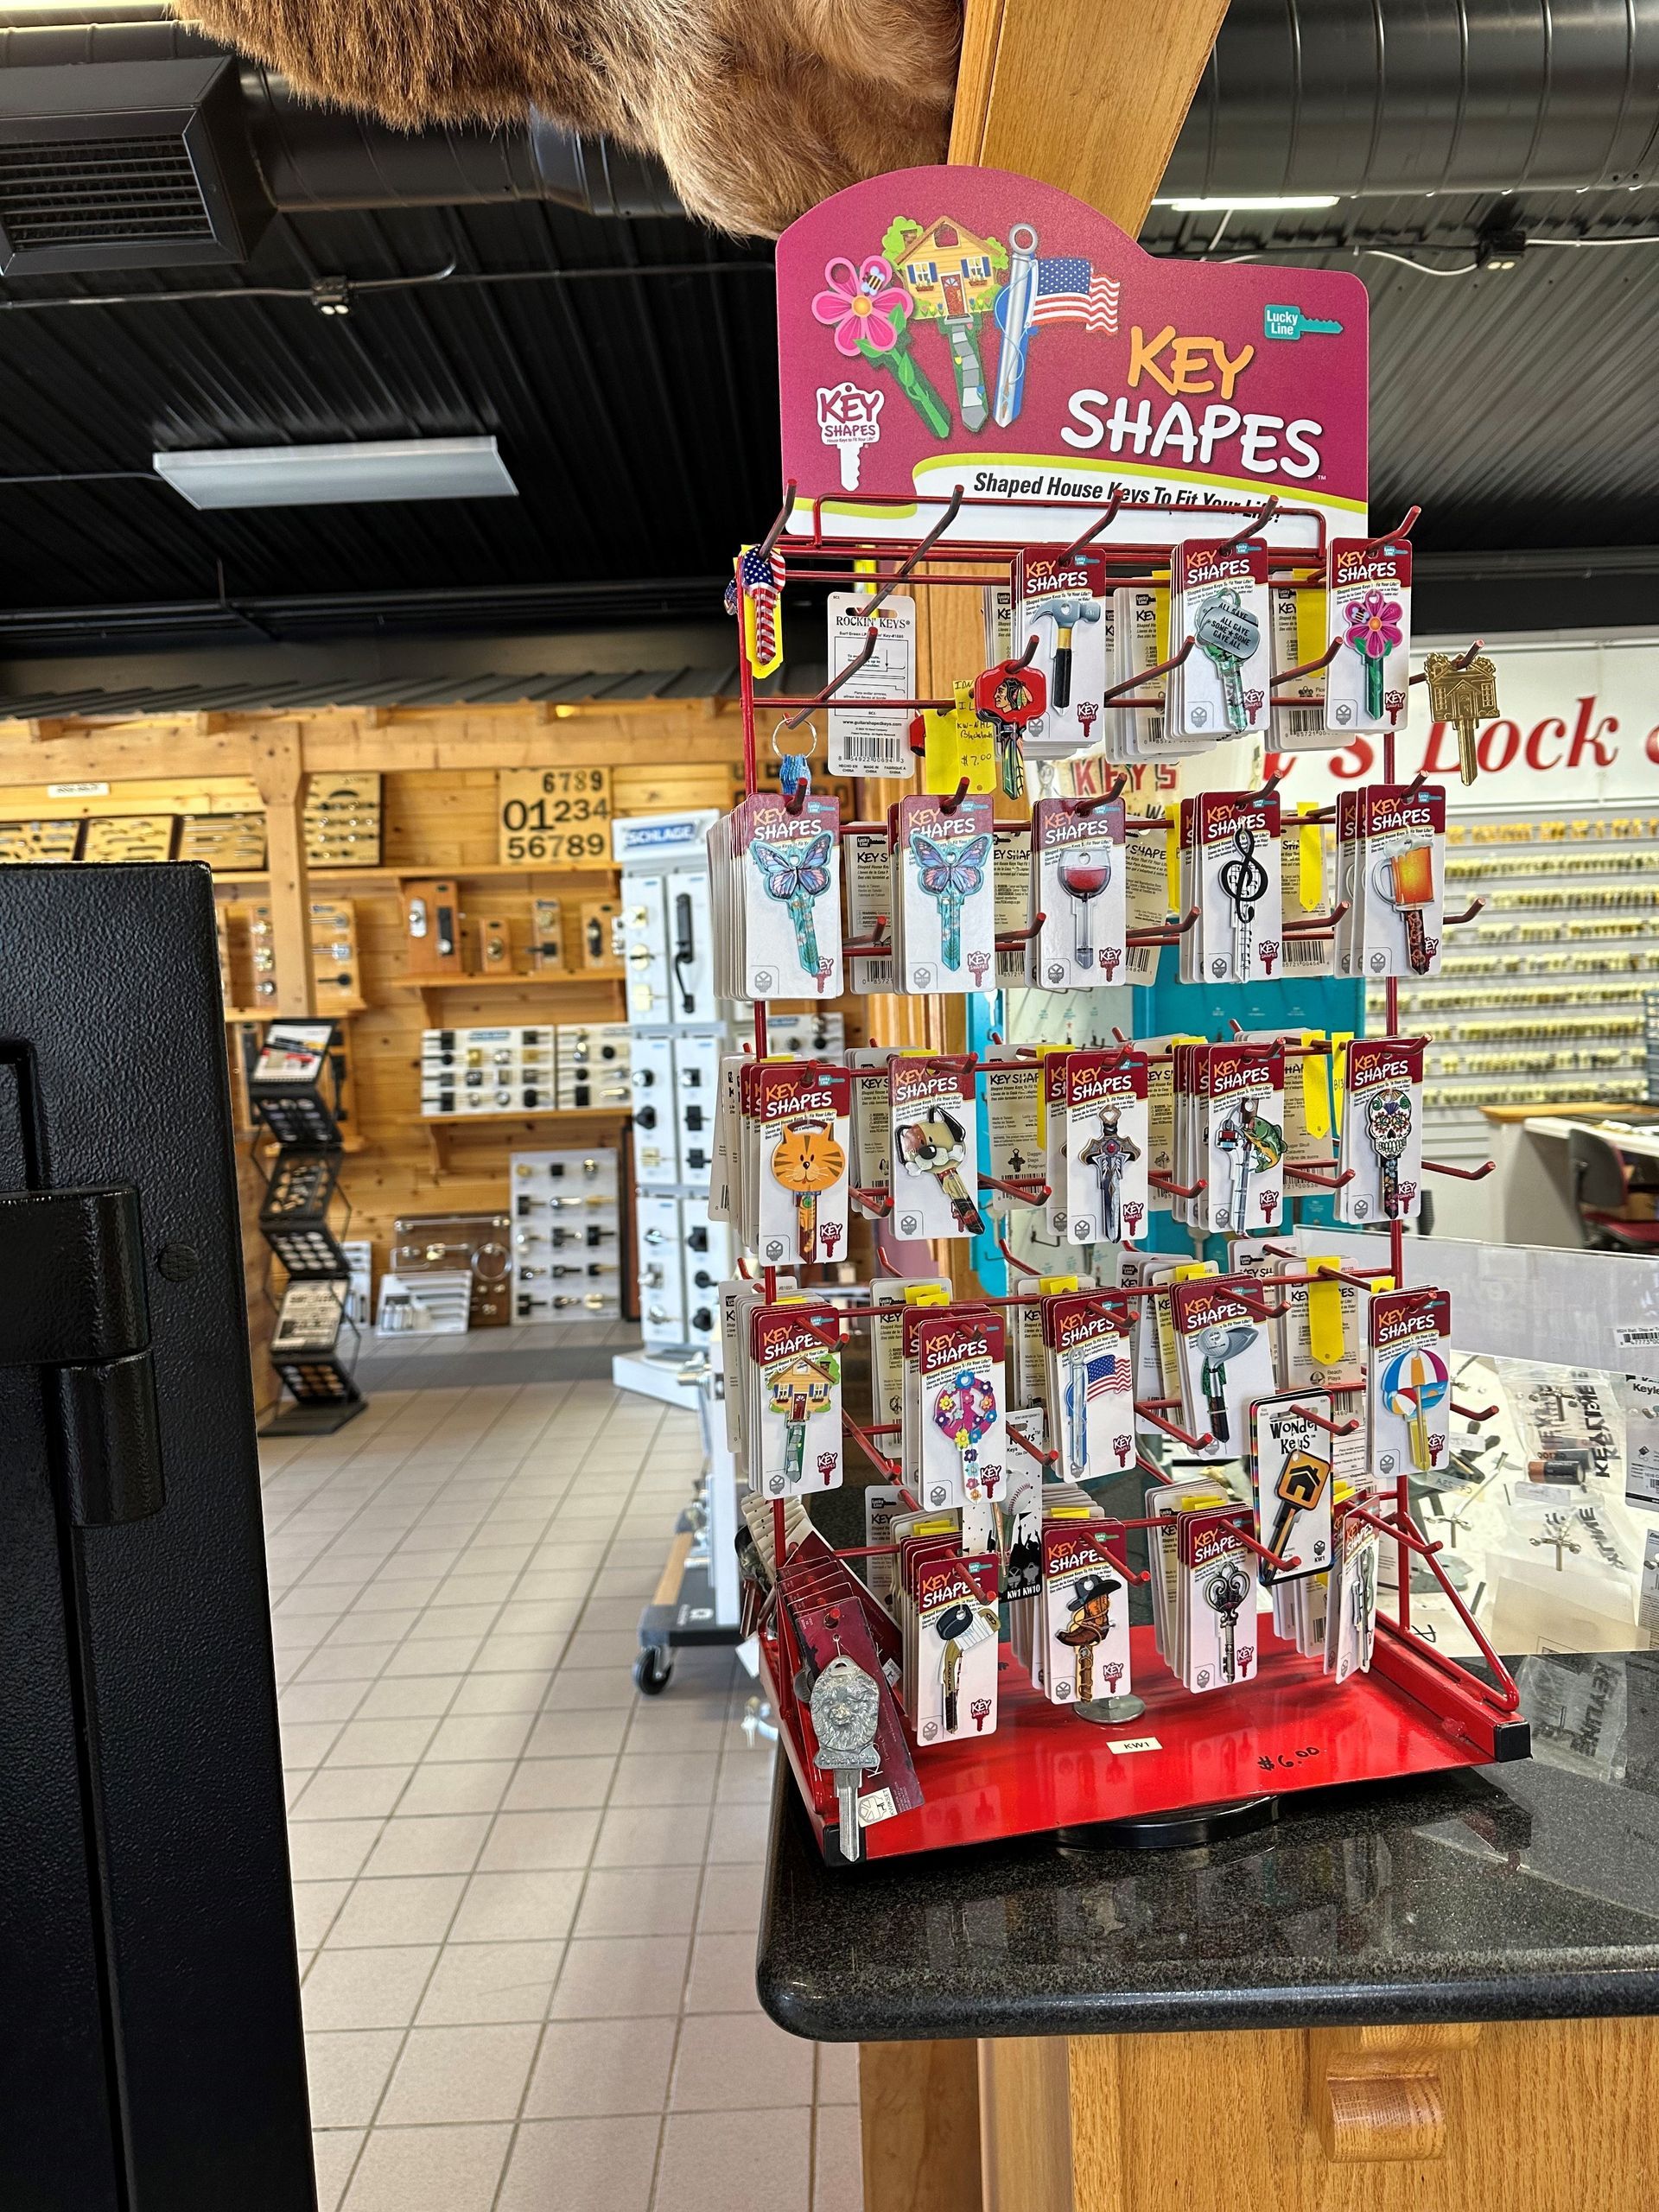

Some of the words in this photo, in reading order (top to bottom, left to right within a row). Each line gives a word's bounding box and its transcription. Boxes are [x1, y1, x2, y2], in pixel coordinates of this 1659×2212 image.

[1266, 309, 1298, 326] Lucky
[1271, 322, 1294, 335] Line
[1127, 325, 1254, 400] KEY
[820, 391, 880, 423] KEY
[824, 425, 875, 436] SHAPES
[1060, 389, 1322, 478] SHAPES
[974, 472, 1044, 498] Shaped
[1047, 477, 1103, 499] House
[1154, 486, 1172, 505] To
[1176, 489, 1198, 505] Fit
[1186, 550, 1217, 569] KEY
[1338, 550, 1365, 568] KEY
[1026, 561, 1056, 578] KEY
[1187, 559, 1249, 584] SHAPES
[1338, 563, 1396, 583] SHAPES
[1026, 571, 1088, 594] SHAPES
[836, 616, 876, 626] ROCKIN'
[1220, 617, 1231, 627] ALL
[1232, 622, 1250, 636] GAVE
[1211, 620, 1228, 634] SOME
[1235, 633, 1251, 646] SOME
[1213, 630, 1229, 643] GAVE
[1230, 638, 1241, 650] ALL
[1385, 691, 1404, 704] KEY
[1077, 704, 1098, 715] KEY
[1419, 696, 1620, 778] Lock
[753, 808, 787, 826] KEY
[1207, 804, 1236, 823] KEY
[1371, 798, 1401, 817] KEY
[908, 808, 941, 828] KEY
[1044, 812, 1075, 830] KEY
[1208, 813, 1266, 838] SHAPES
[1371, 808, 1431, 831] SHAPES
[626, 824, 691, 846] SCHLAGE
[753, 820, 823, 842] SHAPES
[1045, 820, 1109, 845] SHAPES
[507, 833, 605, 860] 56789
[857, 853, 876, 862] KEY
[1099, 950, 1122, 961] KEY
[1258, 941, 1279, 952] KEY
[968, 951, 990, 965] KEY
[1213, 1058, 1242, 1077] KEY
[1354, 1052, 1381, 1072] KEY
[895, 1070, 926, 1087] KEY
[989, 1074, 1011, 1085] KEY
[1072, 1067, 1101, 1086] KEY
[1213, 1066, 1269, 1093] SHAPES
[1355, 1060, 1408, 1086] SHAPES
[766, 1082, 799, 1102] KEY
[896, 1077, 958, 1101] SHAPES
[1072, 1075, 1132, 1102] SHAPES
[766, 1090, 833, 1118] SHAPES
[1399, 1181, 1416, 1192] KEY
[1260, 1192, 1278, 1203] KEY
[1122, 1204, 1143, 1215] KEY
[820, 1224, 842, 1236] KEY
[1184, 1296, 1214, 1315] KEY
[1060, 1312, 1085, 1333] KEY
[1187, 1303, 1247, 1330] SHAPES
[1379, 1307, 1405, 1328] KEY
[763, 1325, 792, 1346] KEY
[1061, 1318, 1115, 1347] SHAPES
[1379, 1313, 1435, 1342] SHAPES
[765, 1332, 823, 1361] SHAPE
[925, 1332, 954, 1354] KEY
[926, 1339, 988, 1369] SHAPES
[1113, 1436, 1131, 1449] KEY
[817, 1452, 837, 1466] KEY
[980, 1467, 1001, 1478] KEY
[1194, 1530, 1218, 1549] KEY
[1346, 1522, 1373, 1557] SHAPES
[1048, 1541, 1077, 1560] KEY
[1314, 1554, 1325, 1563] KW1
[922, 1572, 950, 1593] KEY
[1007, 1590, 1021, 1599] KW1
[1022, 1585, 1040, 1596] KW10
[1236, 1647, 1254, 1659] KEY
[1103, 1663, 1123, 1675] KEY
[971, 1700, 991, 1712] KEY
[1123, 1741, 1151, 1751] KW1
